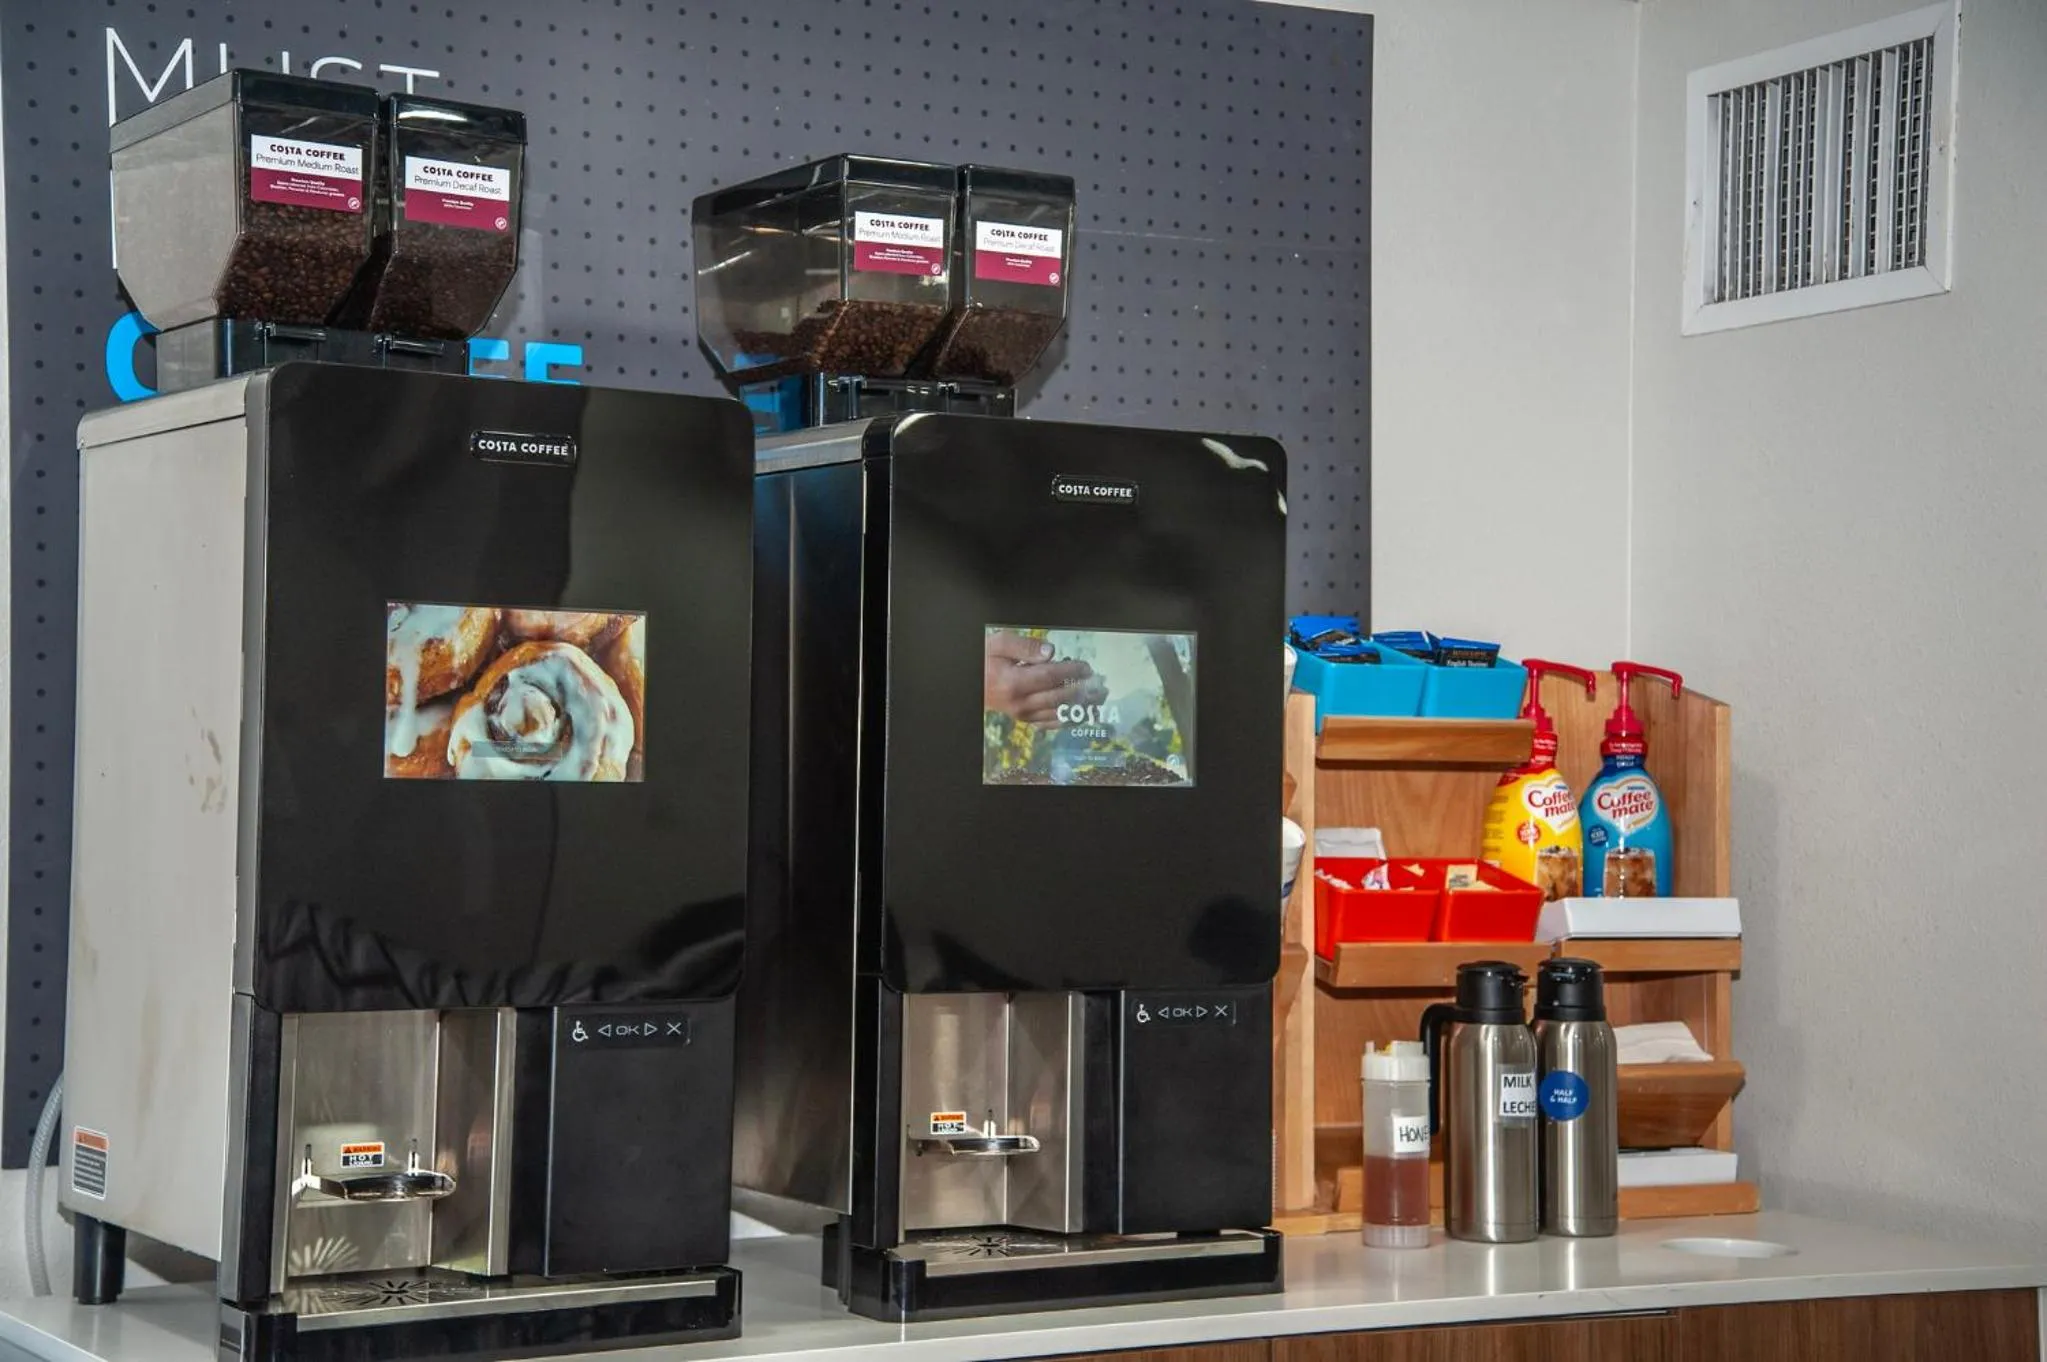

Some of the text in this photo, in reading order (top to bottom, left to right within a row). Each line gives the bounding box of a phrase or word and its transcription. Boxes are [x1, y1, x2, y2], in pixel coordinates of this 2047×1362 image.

[106, 27, 440, 128] MT
[270, 144, 346, 161] COSTA COFFEE
[256, 153, 360, 175] Premium Medium Roast
[423, 166, 494, 182] COSTA COFFEE
[414, 175, 502, 195] Premium Decaf Roast
[870, 219, 930, 231] COSTA COFFEE
[990, 228, 1049, 241] COSTA COFFEE
[478, 440, 568, 456] COSTA COFFEE
[1058, 484, 1133, 498] COSTA COFFEE
[1056, 703, 1121, 726] COSTA
[1070, 728, 1109, 738] COFFEE
[1597, 791, 1652, 810] Coffee
[1611, 800, 1654, 819] mate
[1172, 1008, 1193, 1018] OK
[616, 1025, 640, 1035] OK
[1503, 1076, 1532, 1088] MILK
[1553, 1089, 1574, 1097] HALF
[1557, 1096, 1578, 1104] HALF
[1503, 1101, 1536, 1114] LECHE
